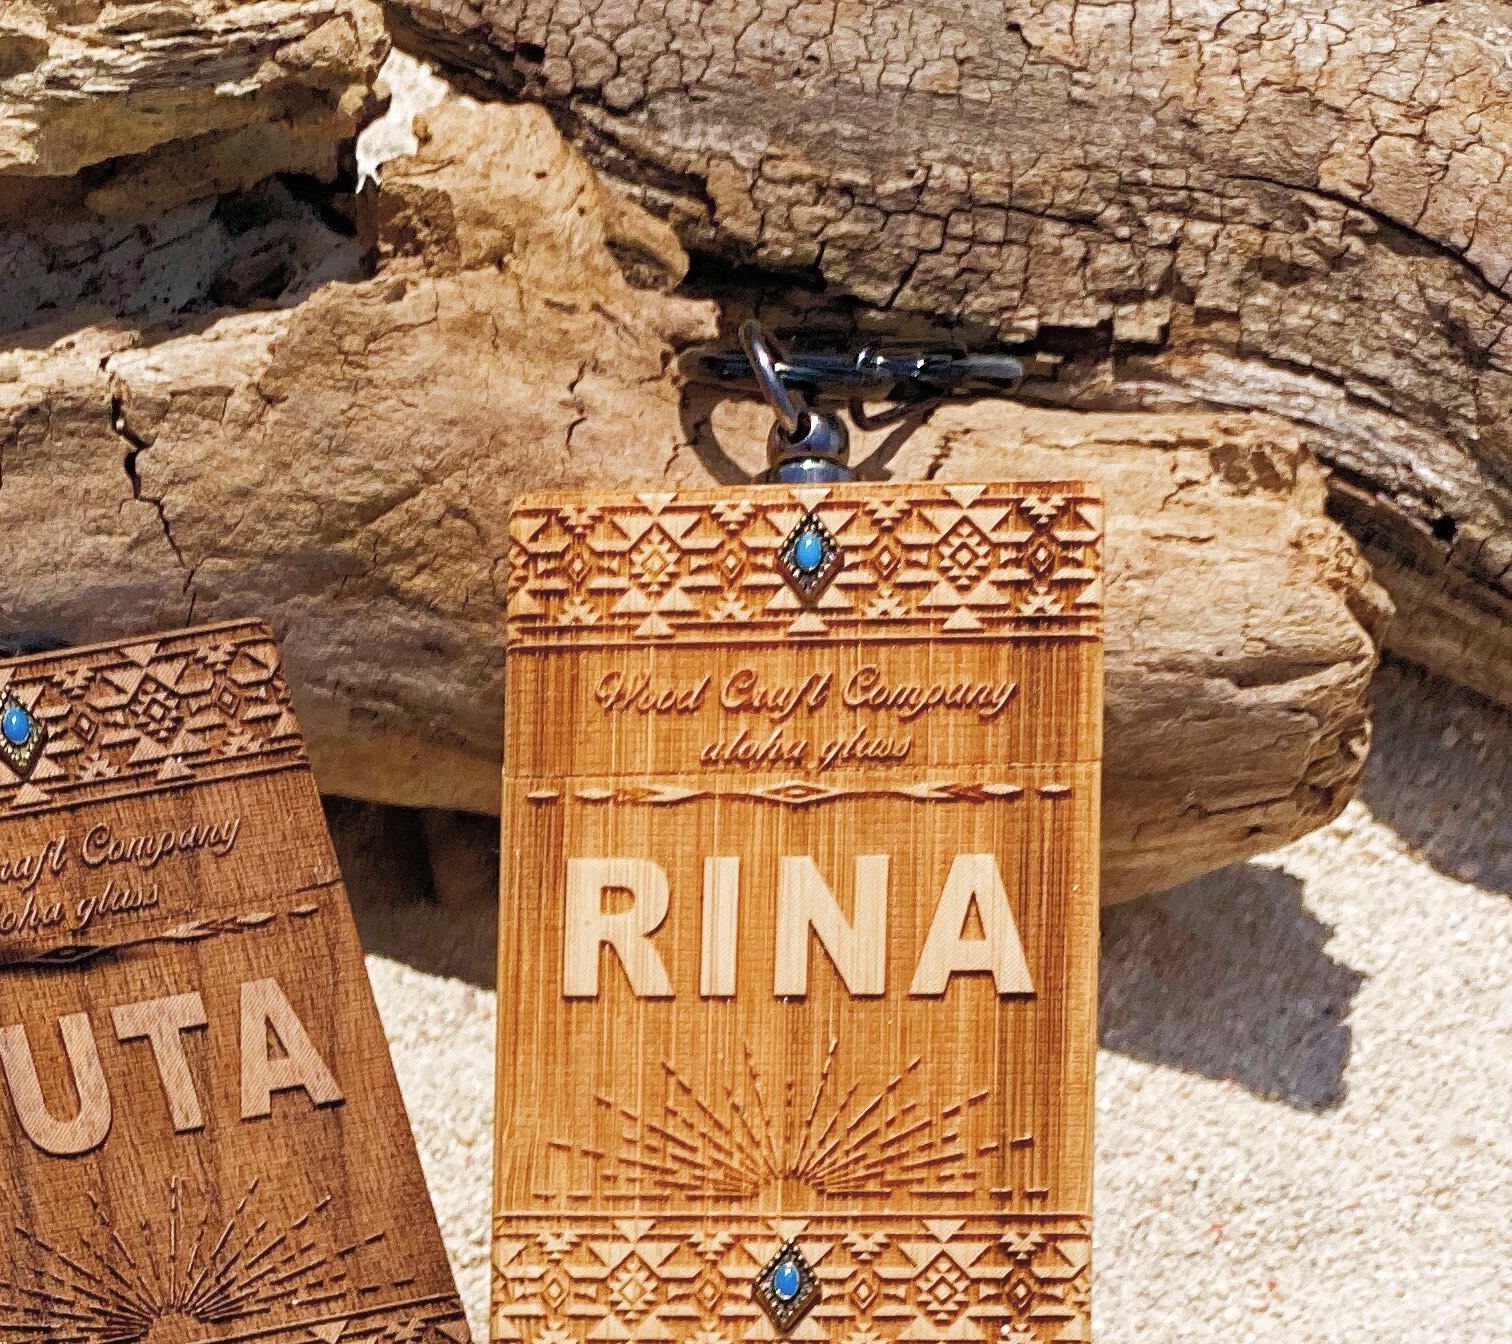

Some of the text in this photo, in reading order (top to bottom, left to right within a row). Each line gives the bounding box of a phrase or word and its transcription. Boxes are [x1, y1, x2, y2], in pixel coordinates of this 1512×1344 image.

[594, 663, 1019, 722] Wood Craft Company
[700, 725, 914, 770] aloha glass
[82, 815, 241, 867] Company
[75, 878, 161, 934] glass
[563, 853, 1037, 1000] RINA
